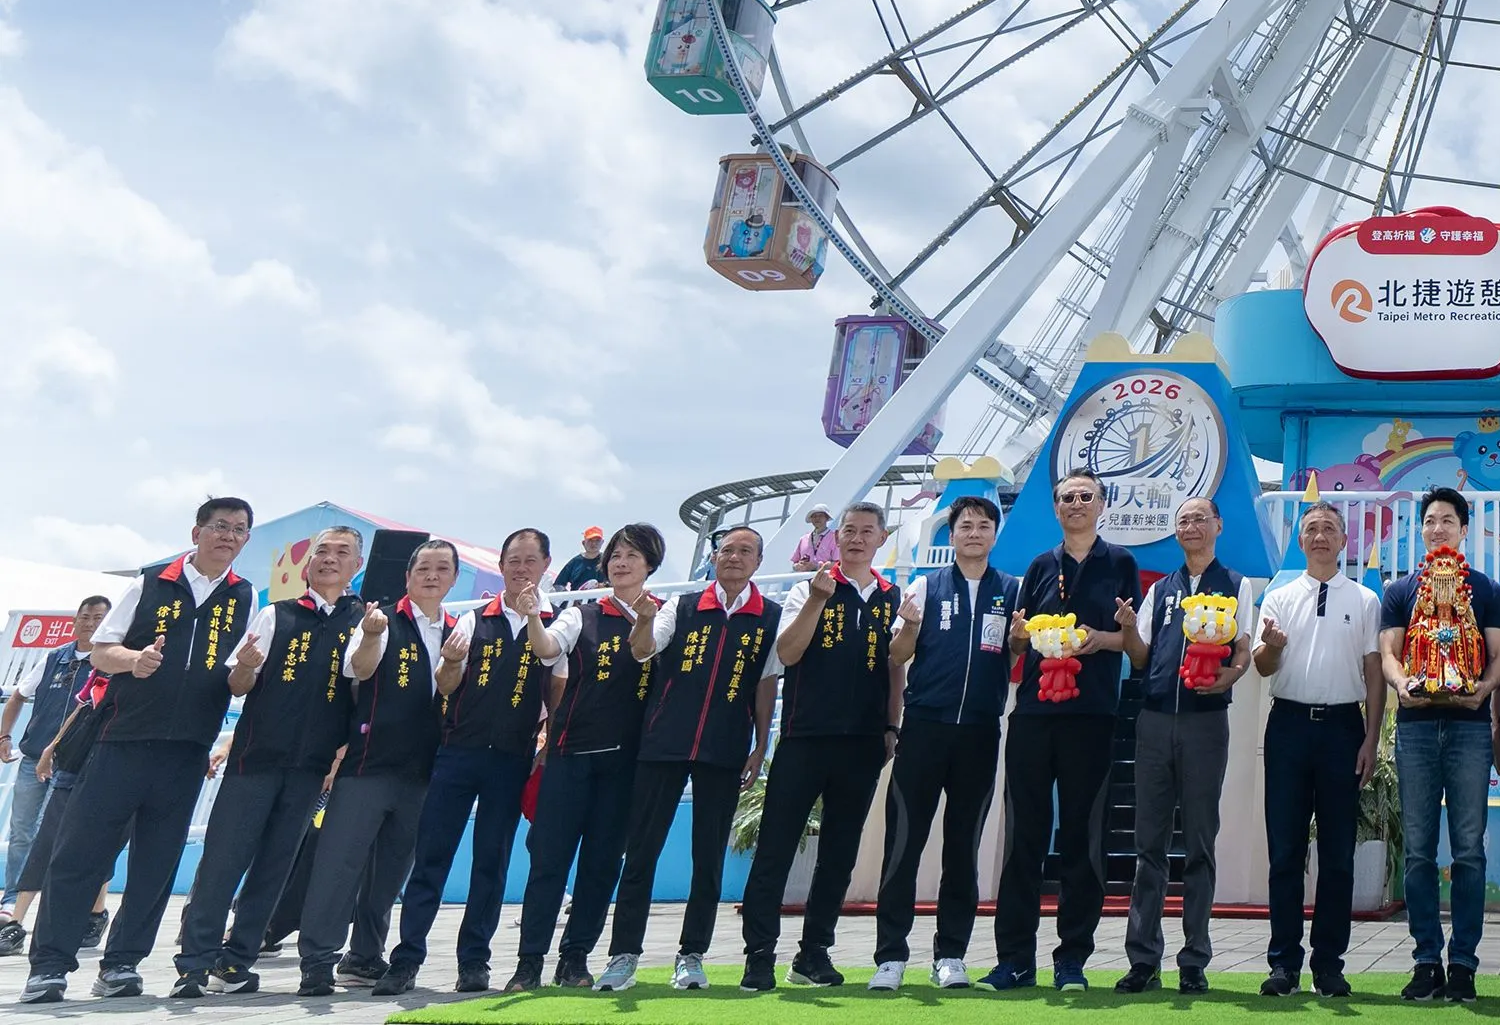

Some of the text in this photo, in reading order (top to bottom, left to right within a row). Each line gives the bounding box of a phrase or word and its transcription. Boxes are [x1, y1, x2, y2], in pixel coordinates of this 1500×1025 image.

[676, 87, 723, 104] 10
[1371, 230, 1484, 241] 登高祈福 守護幸福
[737, 270, 785, 282] 09
[1377, 311, 1410, 322] Taipei
[1413, 312, 1446, 321] Metro
[1112, 379, 1182, 401] 2026
[1108, 512, 1169, 526] 兒童新樂園
[23, 625, 41, 637] EXIT
[46, 621, 75, 638] 出口
[155, 605, 171, 647] 徐正
